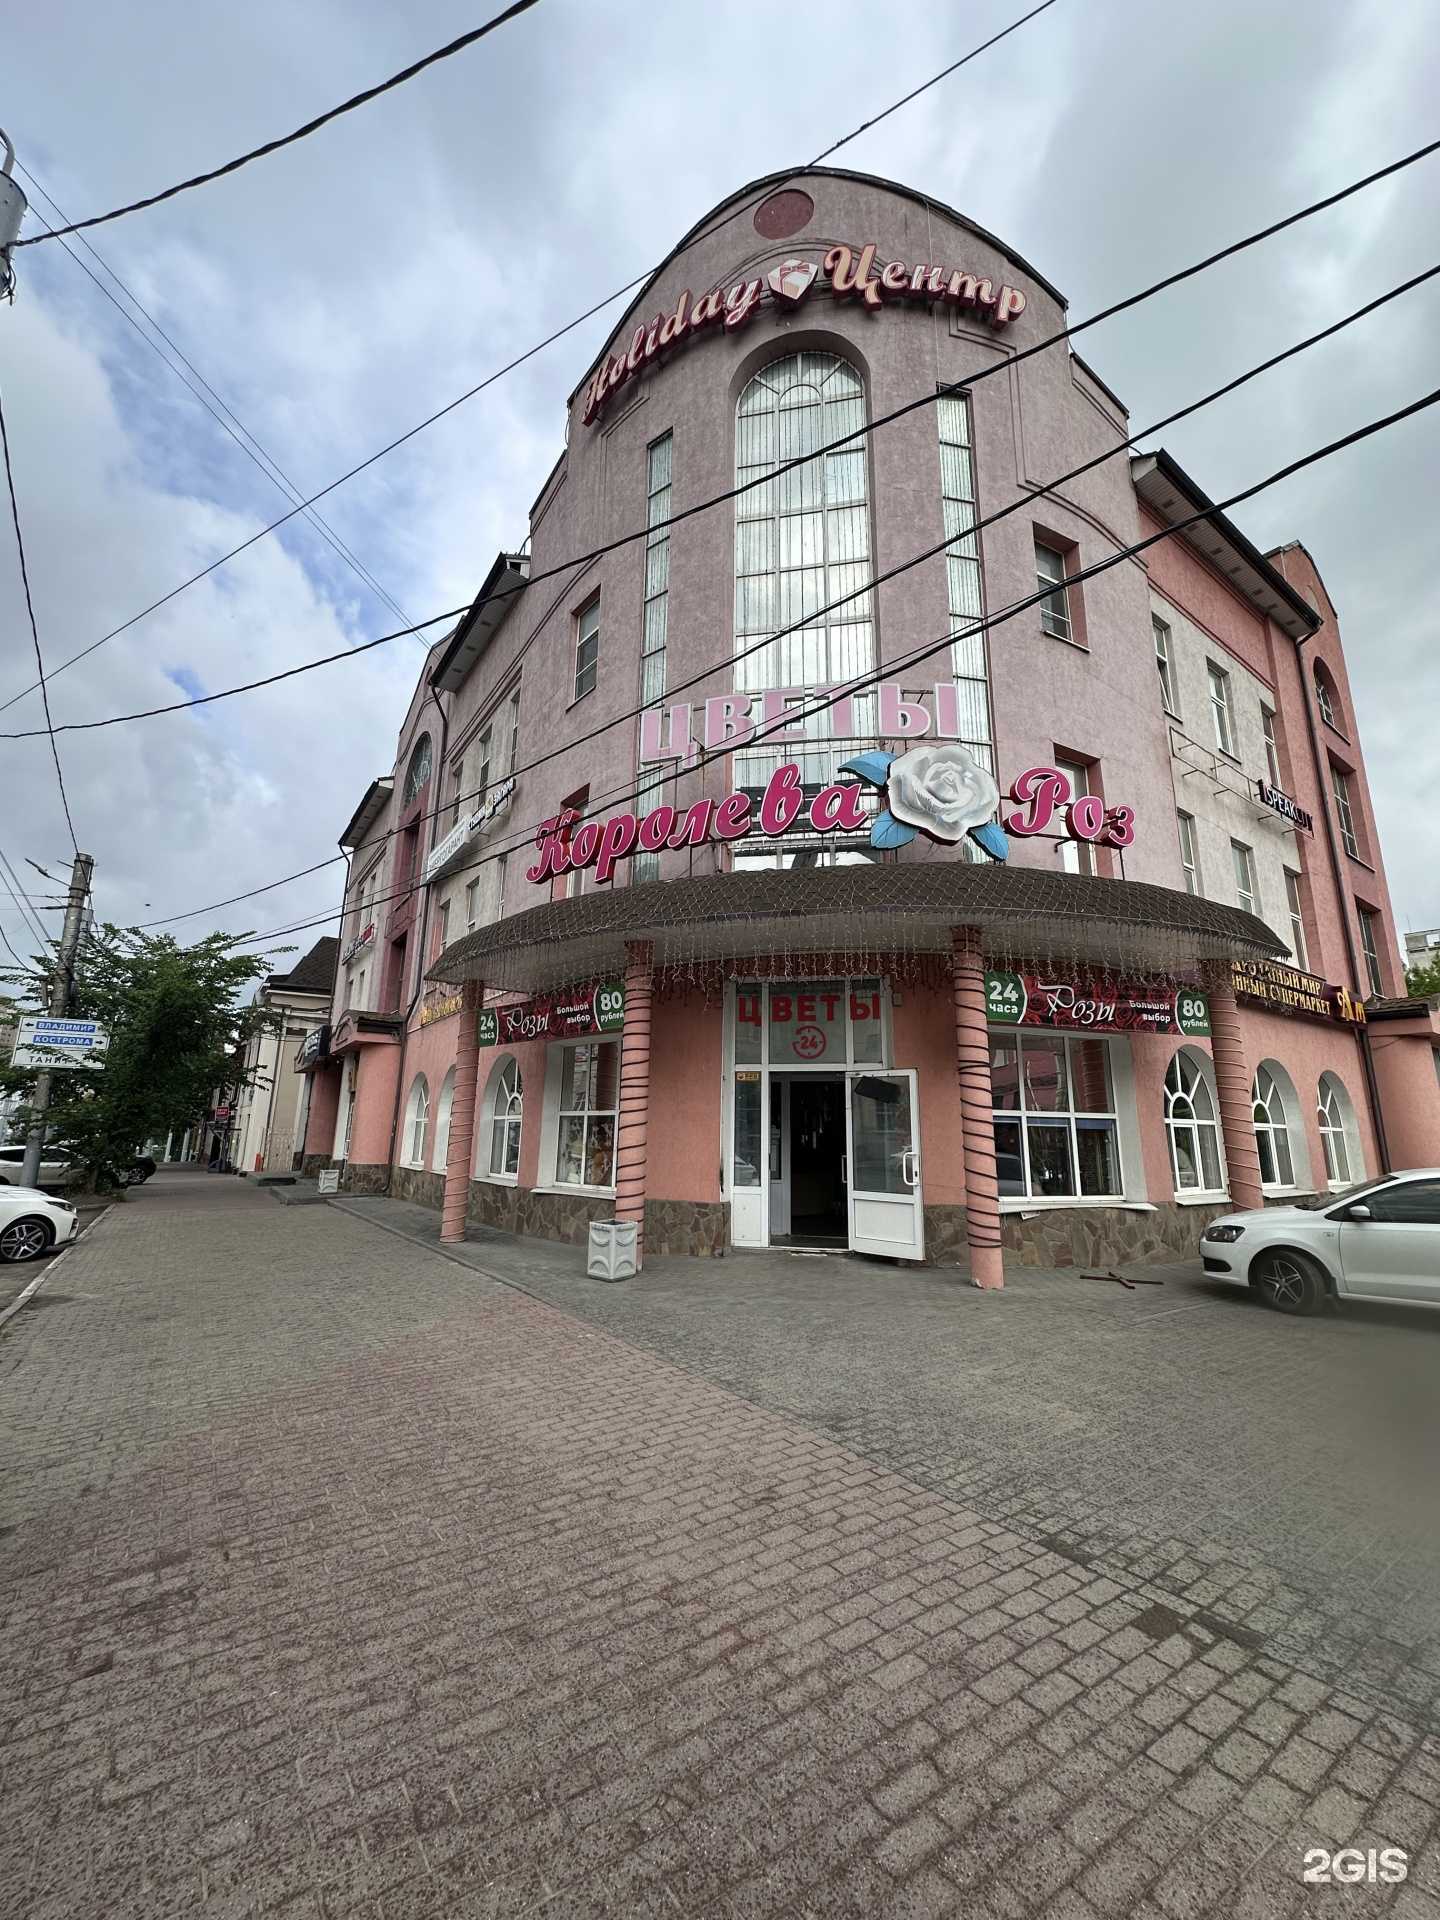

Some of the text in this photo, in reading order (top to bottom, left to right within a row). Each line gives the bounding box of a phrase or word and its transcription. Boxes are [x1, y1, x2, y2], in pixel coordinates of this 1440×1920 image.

[823, 244, 1027, 329] Центр
[583, 277, 762, 426] Holiday
[639, 682, 962, 772] ЦВЕТЫ
[525, 762, 870, 884] Королева
[1003, 766, 1137, 848] Роз
[988, 981, 1019, 1002] 24
[556, 1001, 590, 1015] Большой
[600, 991, 623, 1011] 80
[988, 1003, 1018, 1015] часа
[1037, 982, 1116, 1024] Розы
[1129, 1000, 1170, 1011] Большой
[1182, 999, 1205, 1018] 80
[566, 1013, 591, 1024] выбор
[737, 993, 881, 1028] ЦВЕТЫ
[1142, 1013, 1171, 1024] выбор
[38, 1021, 94, 1032] ВЛАДИМИР
[480, 1014, 495, 1031] 24
[501, 1007, 549, 1038] Розы
[1182, 1019, 1209, 1028] рублей
[34, 1035, 91, 1045] КОСТРОМА
[800, 1035, 818, 1050] 24
